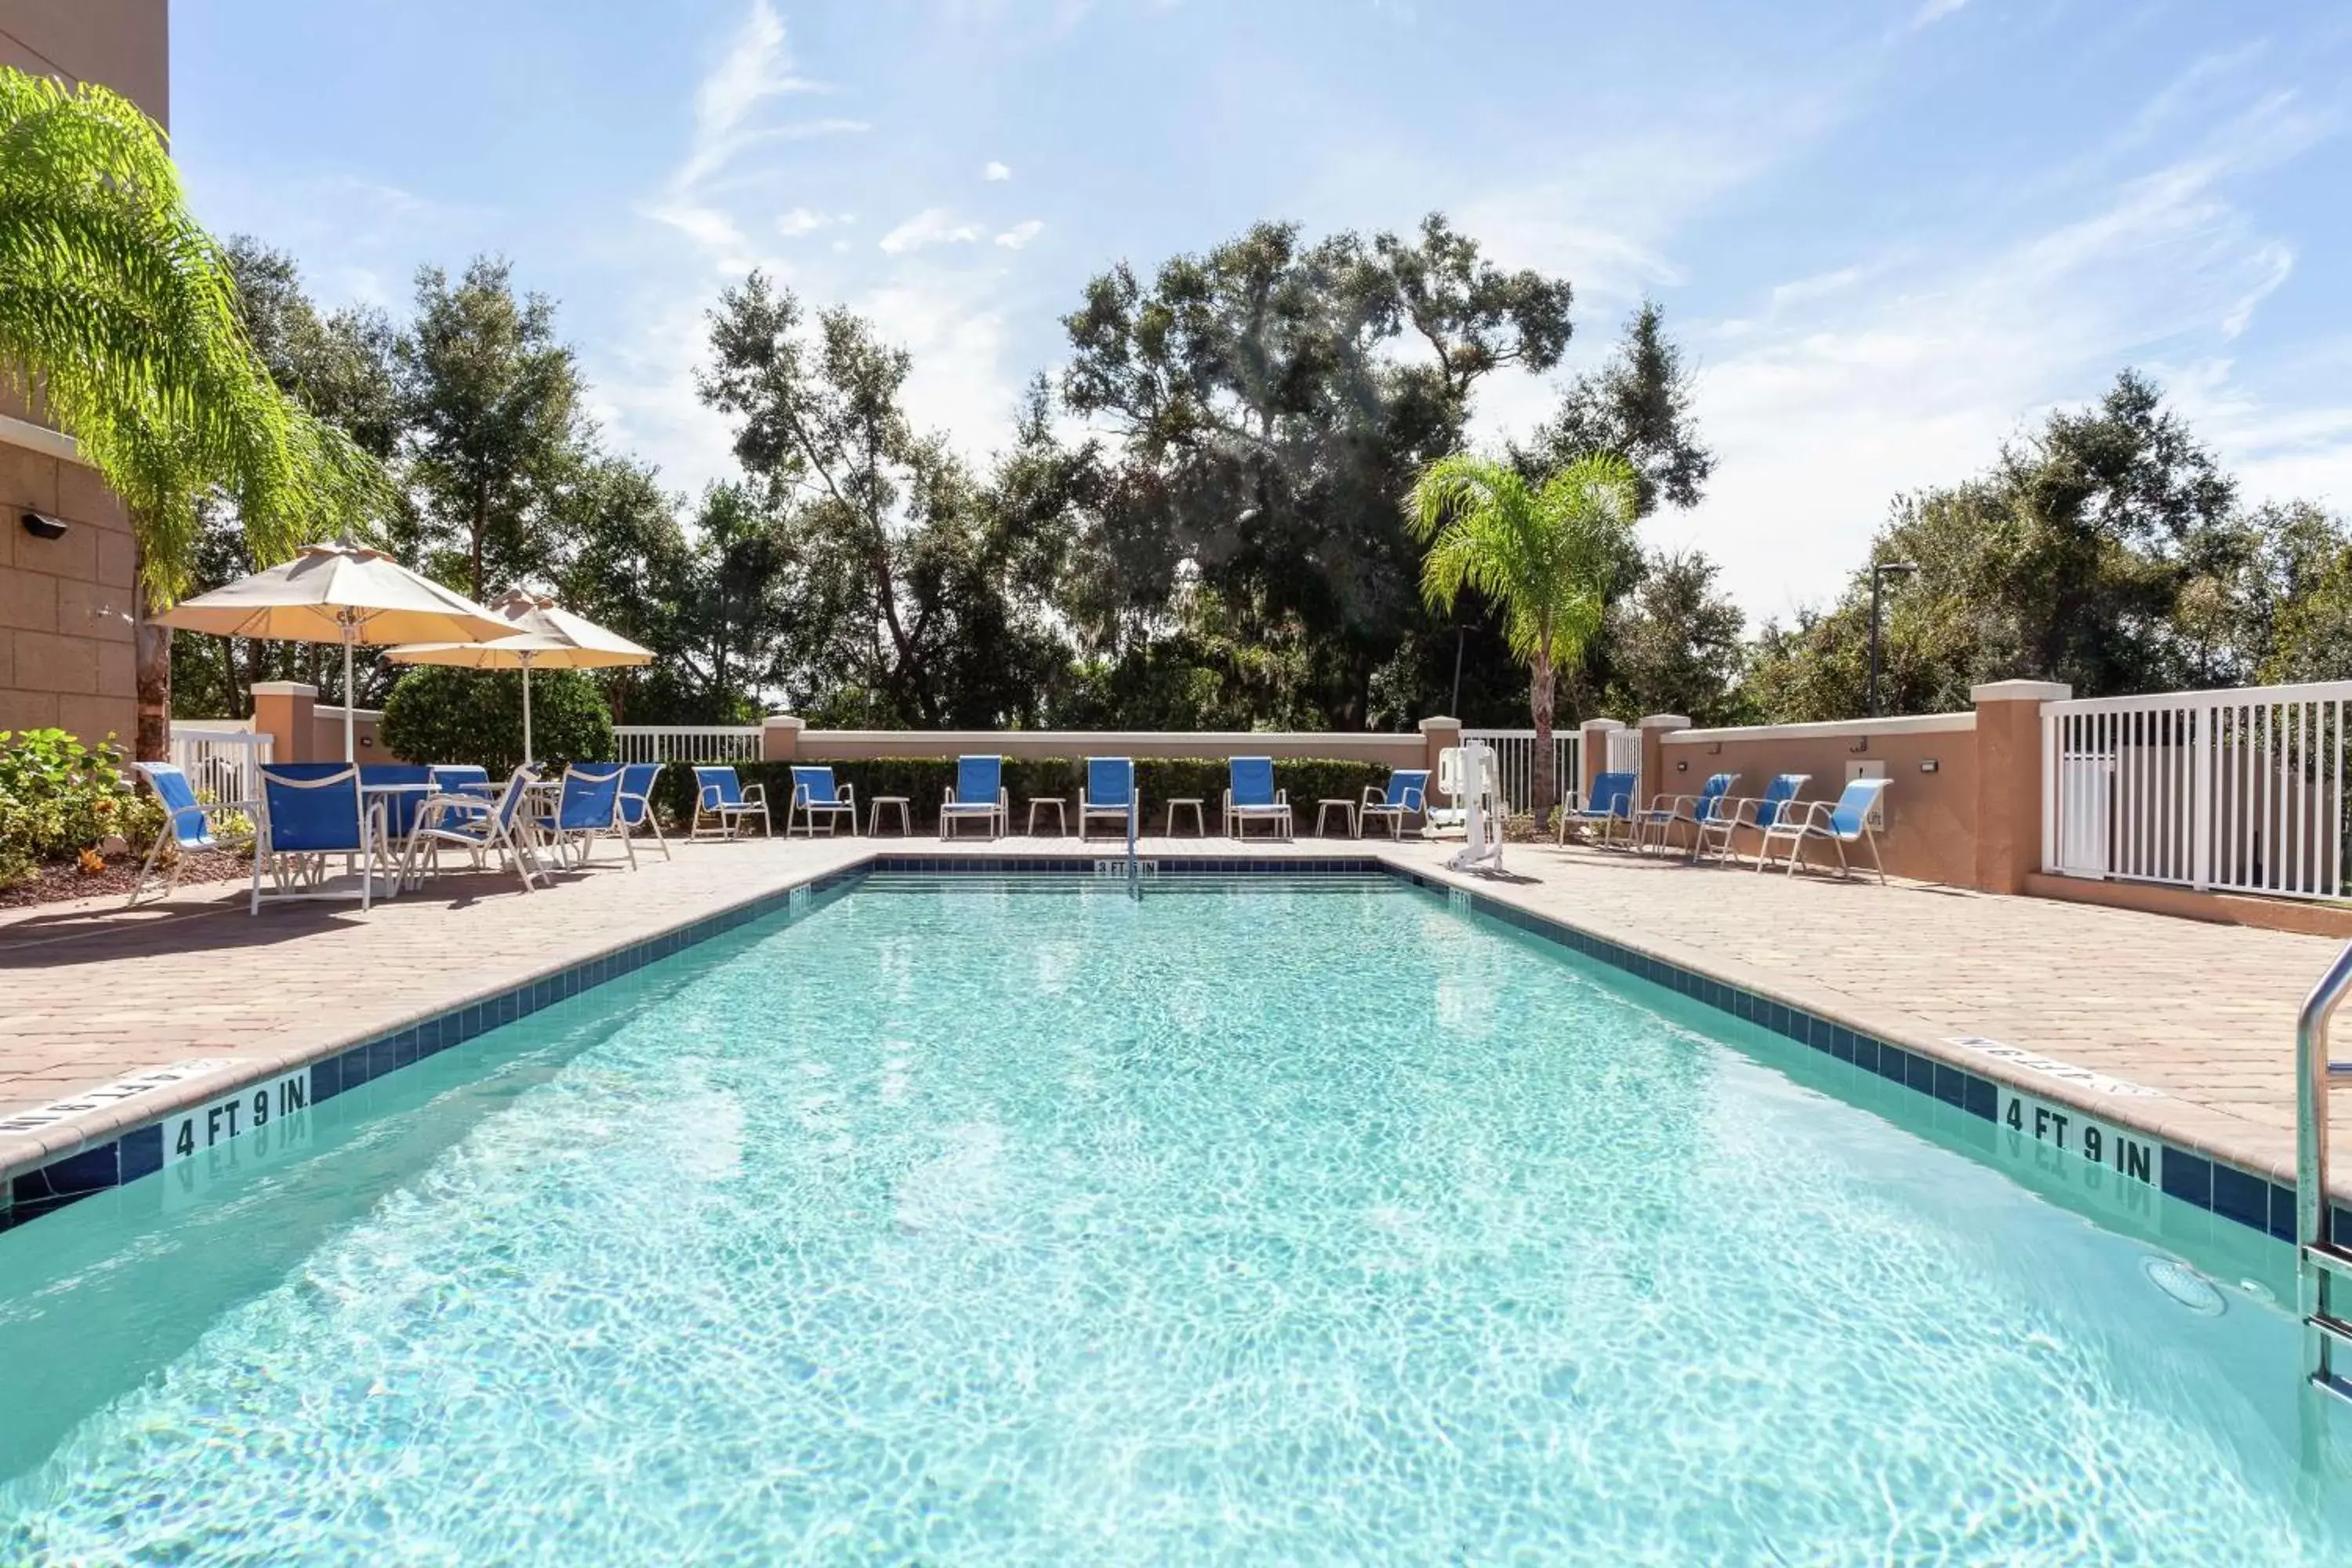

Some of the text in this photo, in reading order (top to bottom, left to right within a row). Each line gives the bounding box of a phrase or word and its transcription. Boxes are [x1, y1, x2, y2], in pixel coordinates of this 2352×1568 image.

[1098, 862, 1106, 873] 3
[1112, 862, 1125, 873] FT
[1142, 862, 1155, 873] IN
[176, 1119, 194, 1156] 4
[254, 1091, 269, 1127] 9
[2006, 1098, 2023, 1131] 4
[2084, 1126, 2102, 1163] 9
